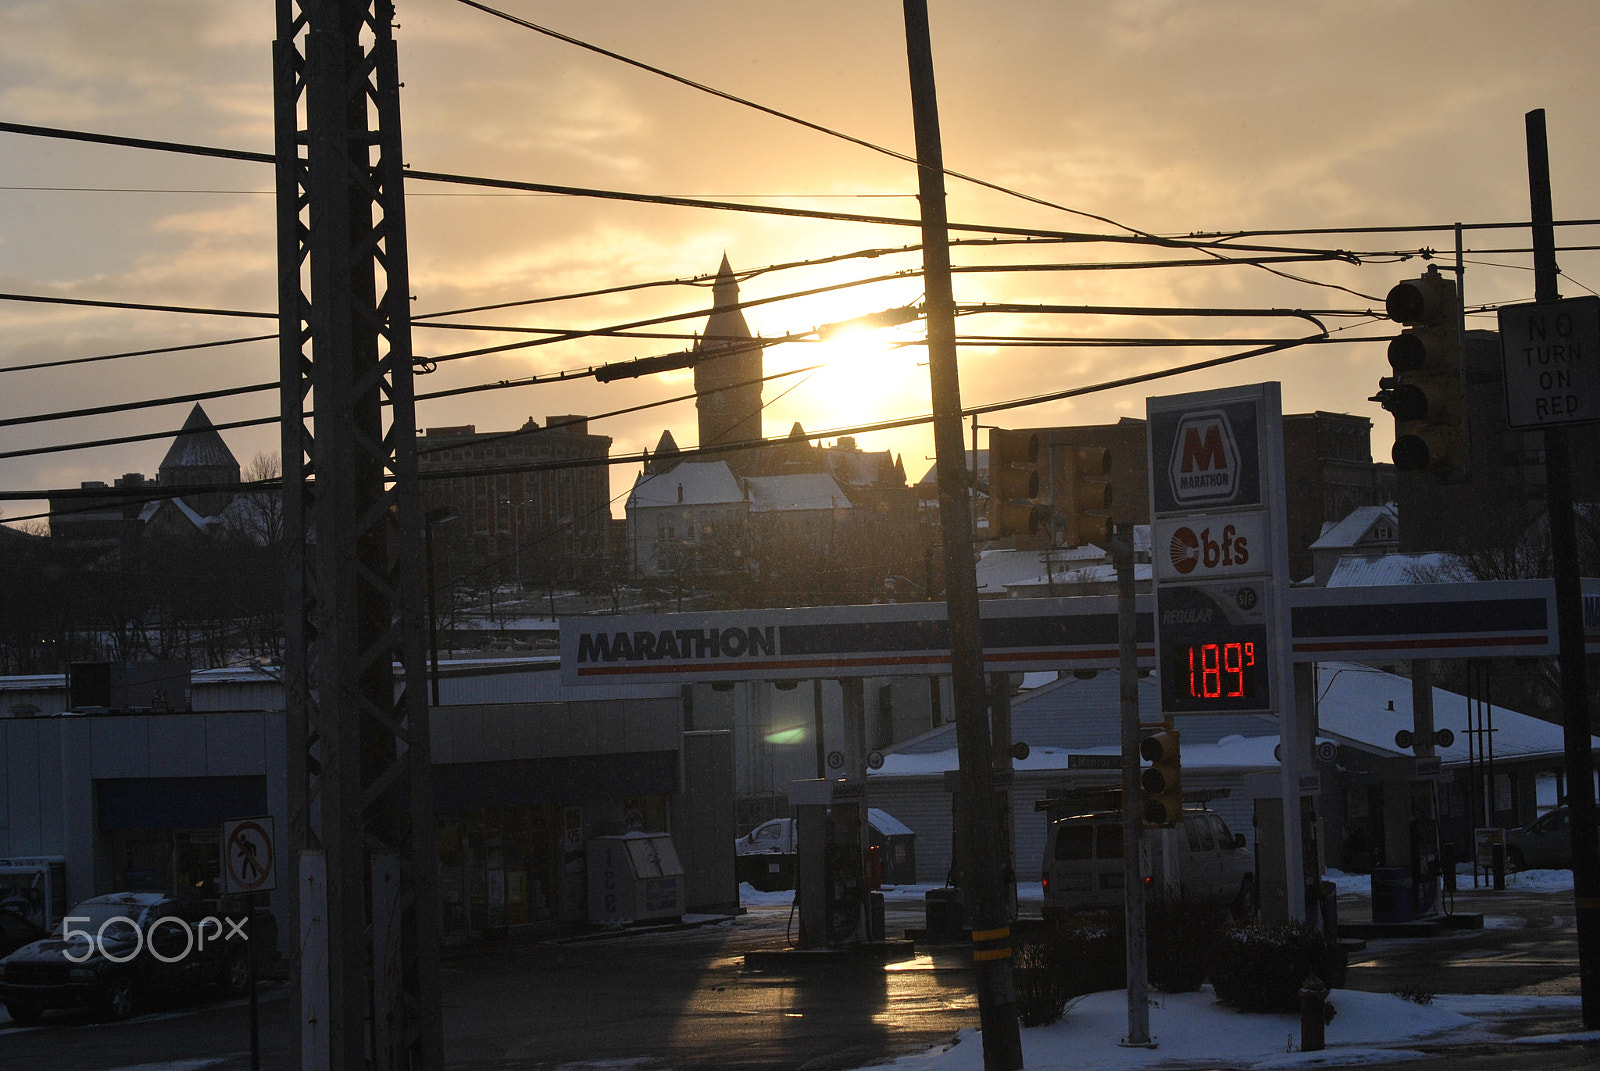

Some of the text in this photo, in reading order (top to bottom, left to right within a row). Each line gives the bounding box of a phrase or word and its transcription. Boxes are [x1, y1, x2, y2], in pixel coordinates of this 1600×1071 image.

[1529, 312, 1573, 340] NO
[1523, 342, 1582, 366] TURN
[1540, 369, 1571, 390] ON
[1536, 395, 1578, 416] RED
[1181, 424, 1228, 474] M
[1180, 473, 1229, 490] MARATHON
[1201, 524, 1249, 568] bfs
[1239, 589, 1255, 607] STP
[1163, 608, 1213, 625] REGULAR
[577, 626, 776, 663] MARATHON
